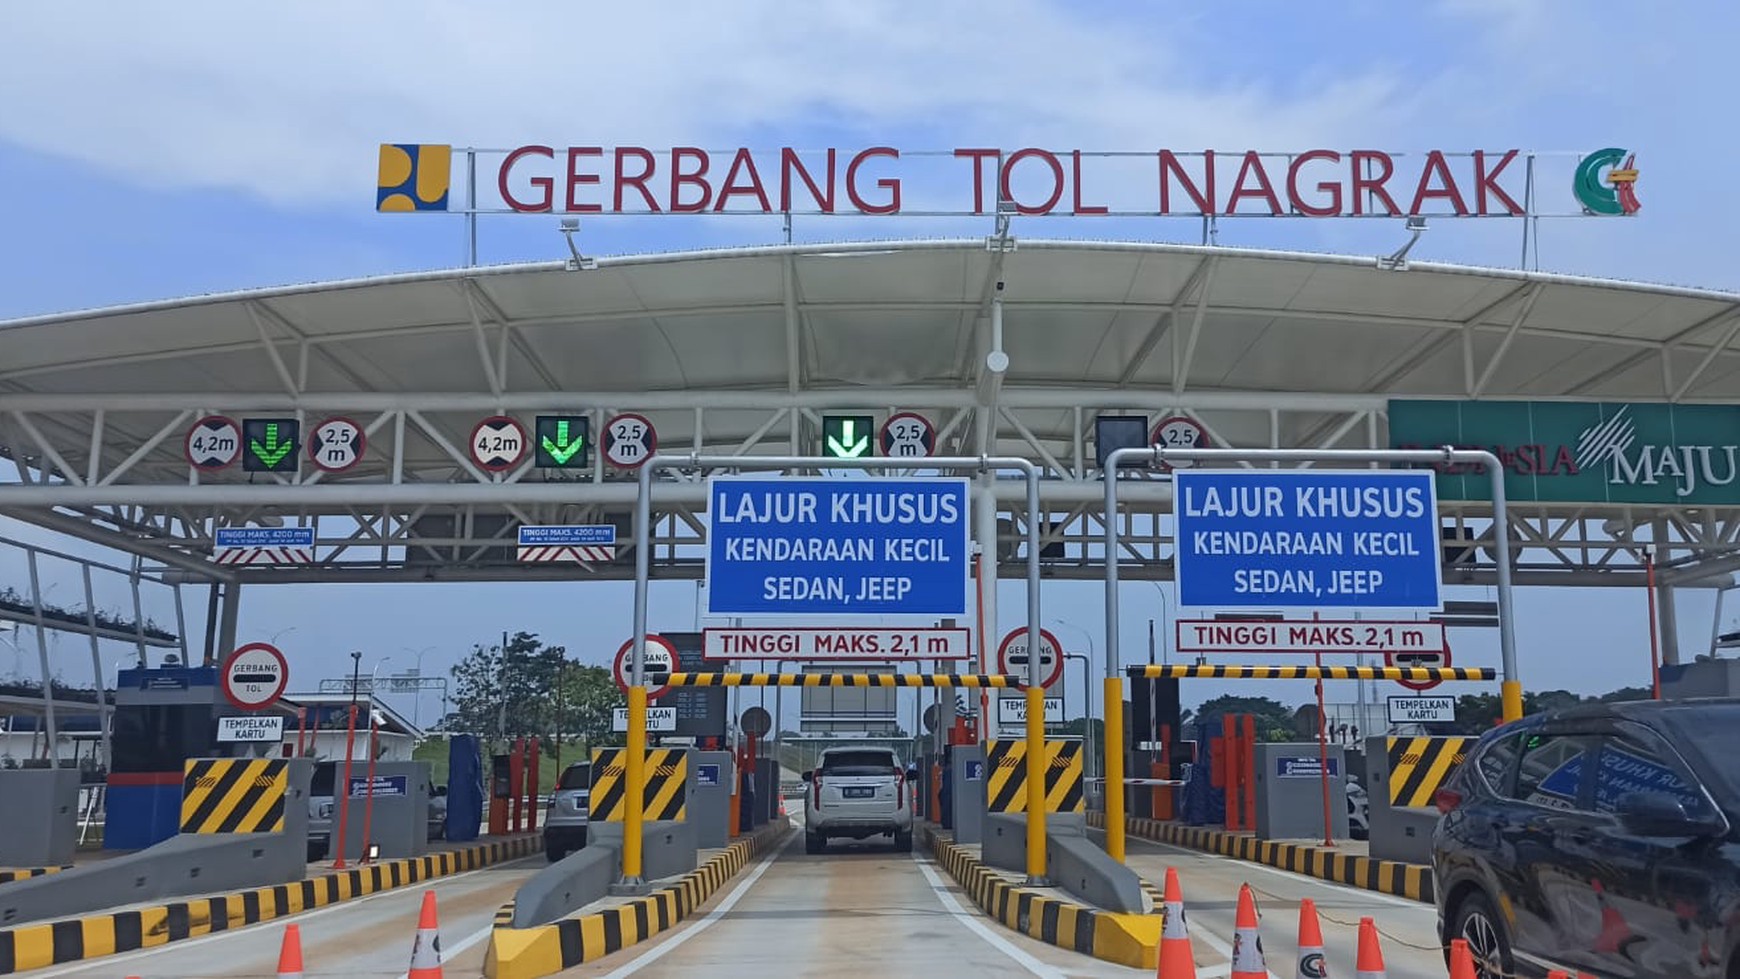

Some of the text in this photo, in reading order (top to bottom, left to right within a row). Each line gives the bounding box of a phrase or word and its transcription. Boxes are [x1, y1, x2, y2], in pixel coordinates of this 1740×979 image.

[498, 145, 1526, 217] GERBANG TOL NAGRAK
[325, 429, 350, 445] 2,5
[617, 425, 641, 441] 2,5
[896, 425, 920, 441] 2,5
[1169, 429, 1193, 445] 2,5
[193, 436, 234, 454] 4,2m
[478, 436, 518, 453] 4,2m
[621, 444, 638, 456] m
[900, 444, 917, 456] m
[328, 449, 345, 461] m
[1610, 445, 1738, 496] MAJU
[719, 493, 958, 524] LAJUR KHUSUS
[1185, 487, 1424, 518] LAJUR KHUSUS
[726, 538, 950, 562] KENDARAAN KECIL
[1194, 531, 1419, 556] KENDARAAN KECIL
[763, 577, 912, 605] SEDAN, JEEP
[1234, 570, 1384, 598] SEDAN, JEEP
[720, 635, 800, 653] TINGGI
[890, 635, 919, 656] 2,1
[928, 637, 949, 653] m
[1194, 626, 1277, 645] TINGGI
[1365, 628, 1394, 649] 2,1
[1402, 630, 1424, 646] m
[233, 664, 278, 673] GERBANG
[246, 684, 263, 693] TOL
[1395, 700, 1449, 710] TEMPELKAN
[1407, 710, 1438, 719] KARTU
[225, 719, 278, 729] TEMPELKAN
[235, 729, 265, 739] KARTU
